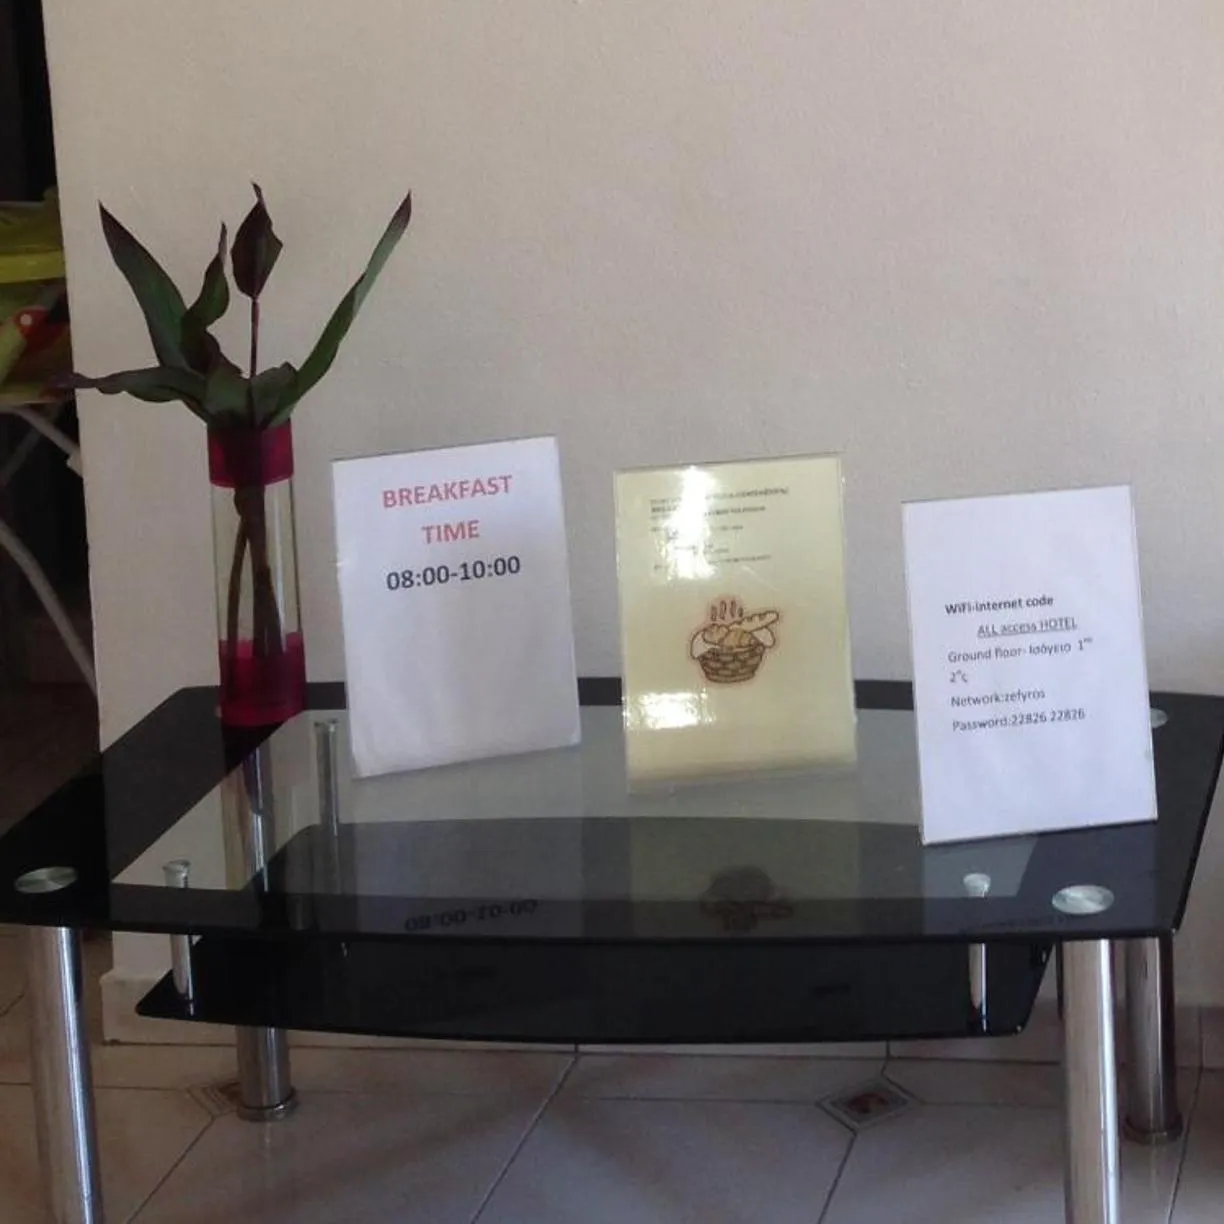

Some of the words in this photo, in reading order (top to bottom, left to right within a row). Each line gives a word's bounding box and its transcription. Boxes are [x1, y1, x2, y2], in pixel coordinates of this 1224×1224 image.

[382, 475, 513, 509] BREAKFAST
[421, 520, 480, 545] TIME
[386, 555, 521, 591] 08:00-10:00
[1025, 594, 1054, 608] code
[977, 624, 998, 638] ALL
[1000, 622, 1037, 636] access
[1039, 616, 1078, 633] HOTEL
[947, 646, 992, 663] Ground
